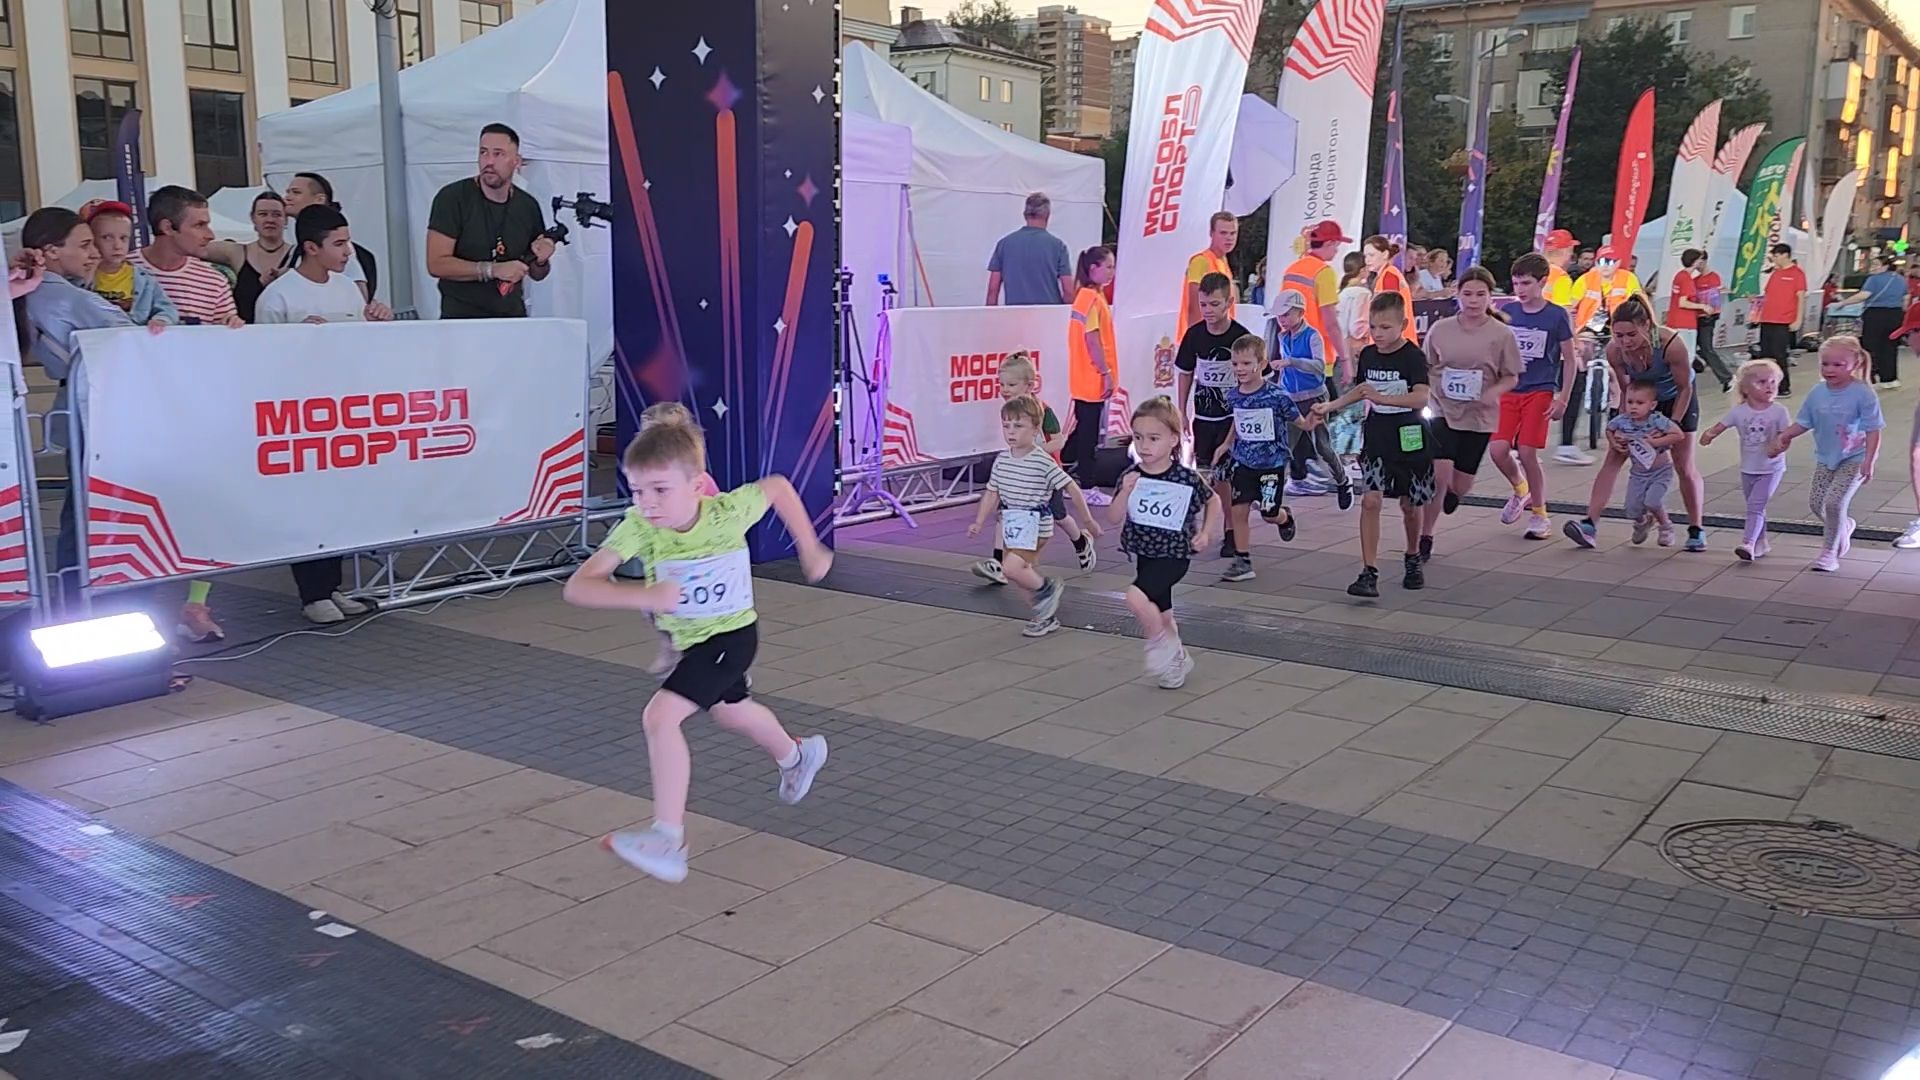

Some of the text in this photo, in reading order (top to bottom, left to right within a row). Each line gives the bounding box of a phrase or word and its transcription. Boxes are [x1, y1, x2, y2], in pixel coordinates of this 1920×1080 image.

[1143, 94, 1183, 238] МОСОБЛ
[1160, 121, 1196, 232] СПОРТ
[1322, 118, 1339, 217] Губернатора
[1304, 152, 1323, 220] Команда
[950, 350, 1041, 378] МОСЛ
[1519, 340, 1534, 351] 39
[1203, 372, 1226, 382] 527
[1367, 369, 1401, 380] UNDER
[255, 387, 470, 437] МОСОБЛ
[1239, 422, 1263, 434] 528
[257, 427, 428, 476] СПОРТ
[1136, 498, 1173, 518] 566
